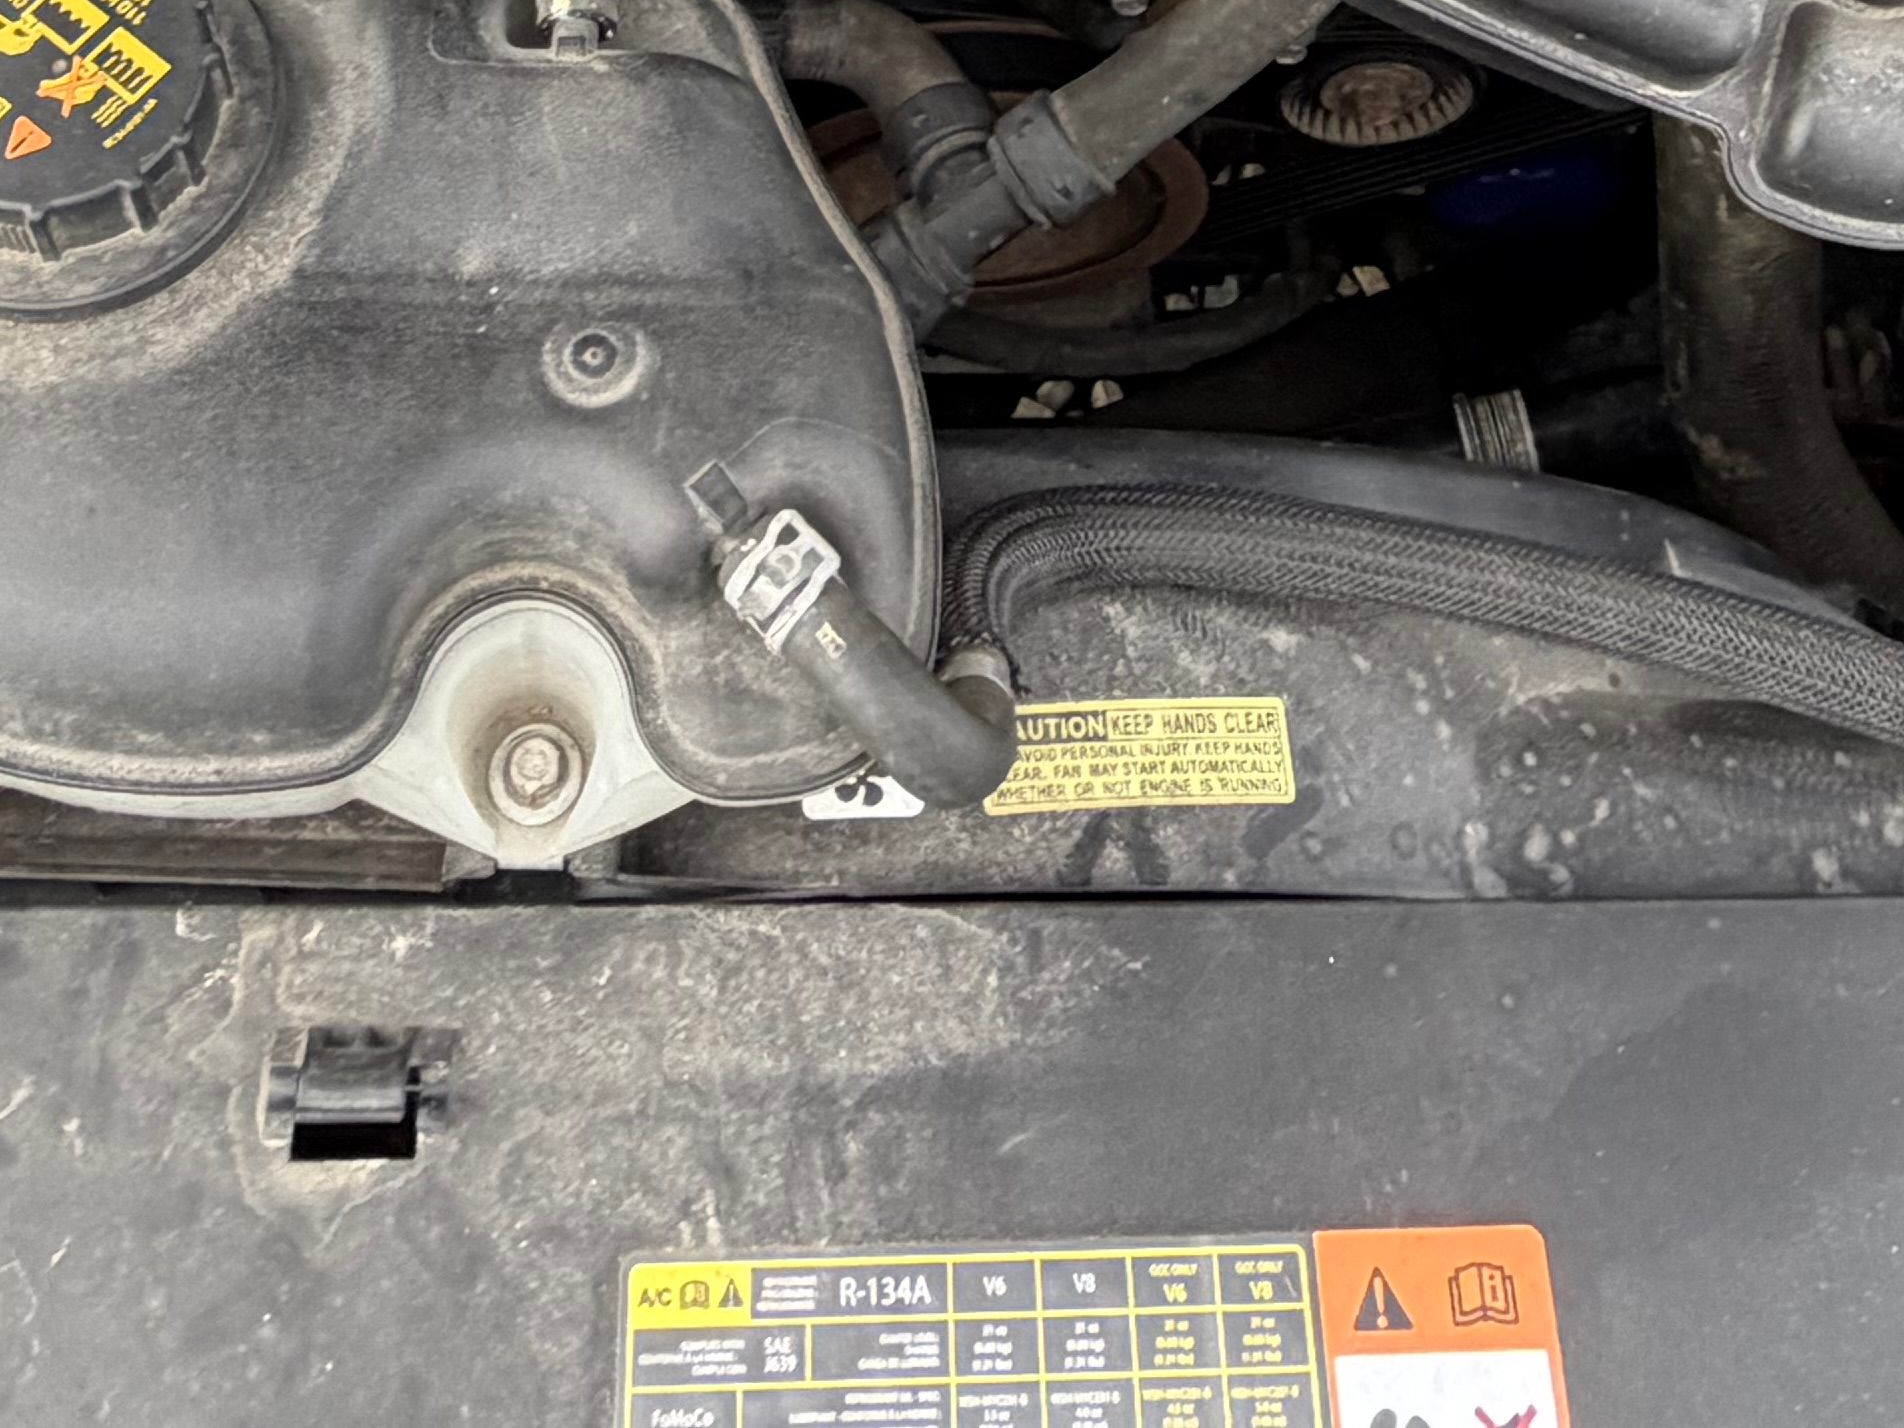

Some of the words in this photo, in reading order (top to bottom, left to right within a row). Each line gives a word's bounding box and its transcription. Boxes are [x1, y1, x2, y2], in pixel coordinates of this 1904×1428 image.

[1016, 715, 1105, 741] AUTION
[1111, 713, 1154, 735] KEEP
[1161, 712, 1218, 734] HANDS
[1223, 711, 1280, 734] CLEAR
[1060, 744, 1135, 761] PERSONAL
[1195, 742, 1231, 755] KEEP
[1234, 741, 1282, 755] HANDS
[1053, 764, 1082, 779] FAN
[1089, 762, 1118, 777] MAY
[1122, 760, 1166, 776] START
[1170, 758, 1284, 775] AUTOMATICALLY
[996, 784, 1067, 802] WHETHER
[1074, 782, 1095, 797] OR
[1103, 780, 1131, 795] NOT
[1140, 778, 1192, 795] ENGINE
[1200, 778, 1214, 793] IS
[1218, 777, 1282, 793] RUNNING
[839, 1275, 932, 1308] R-134A
[982, 1275, 1008, 1297] V6
[1072, 1272, 1097, 1294] V8
[1162, 1282, 1188, 1303] V6
[1249, 1280, 1274, 1300] V8
[638, 1287, 673, 1308] A/C
[763, 1336, 793, 1355] SAE
